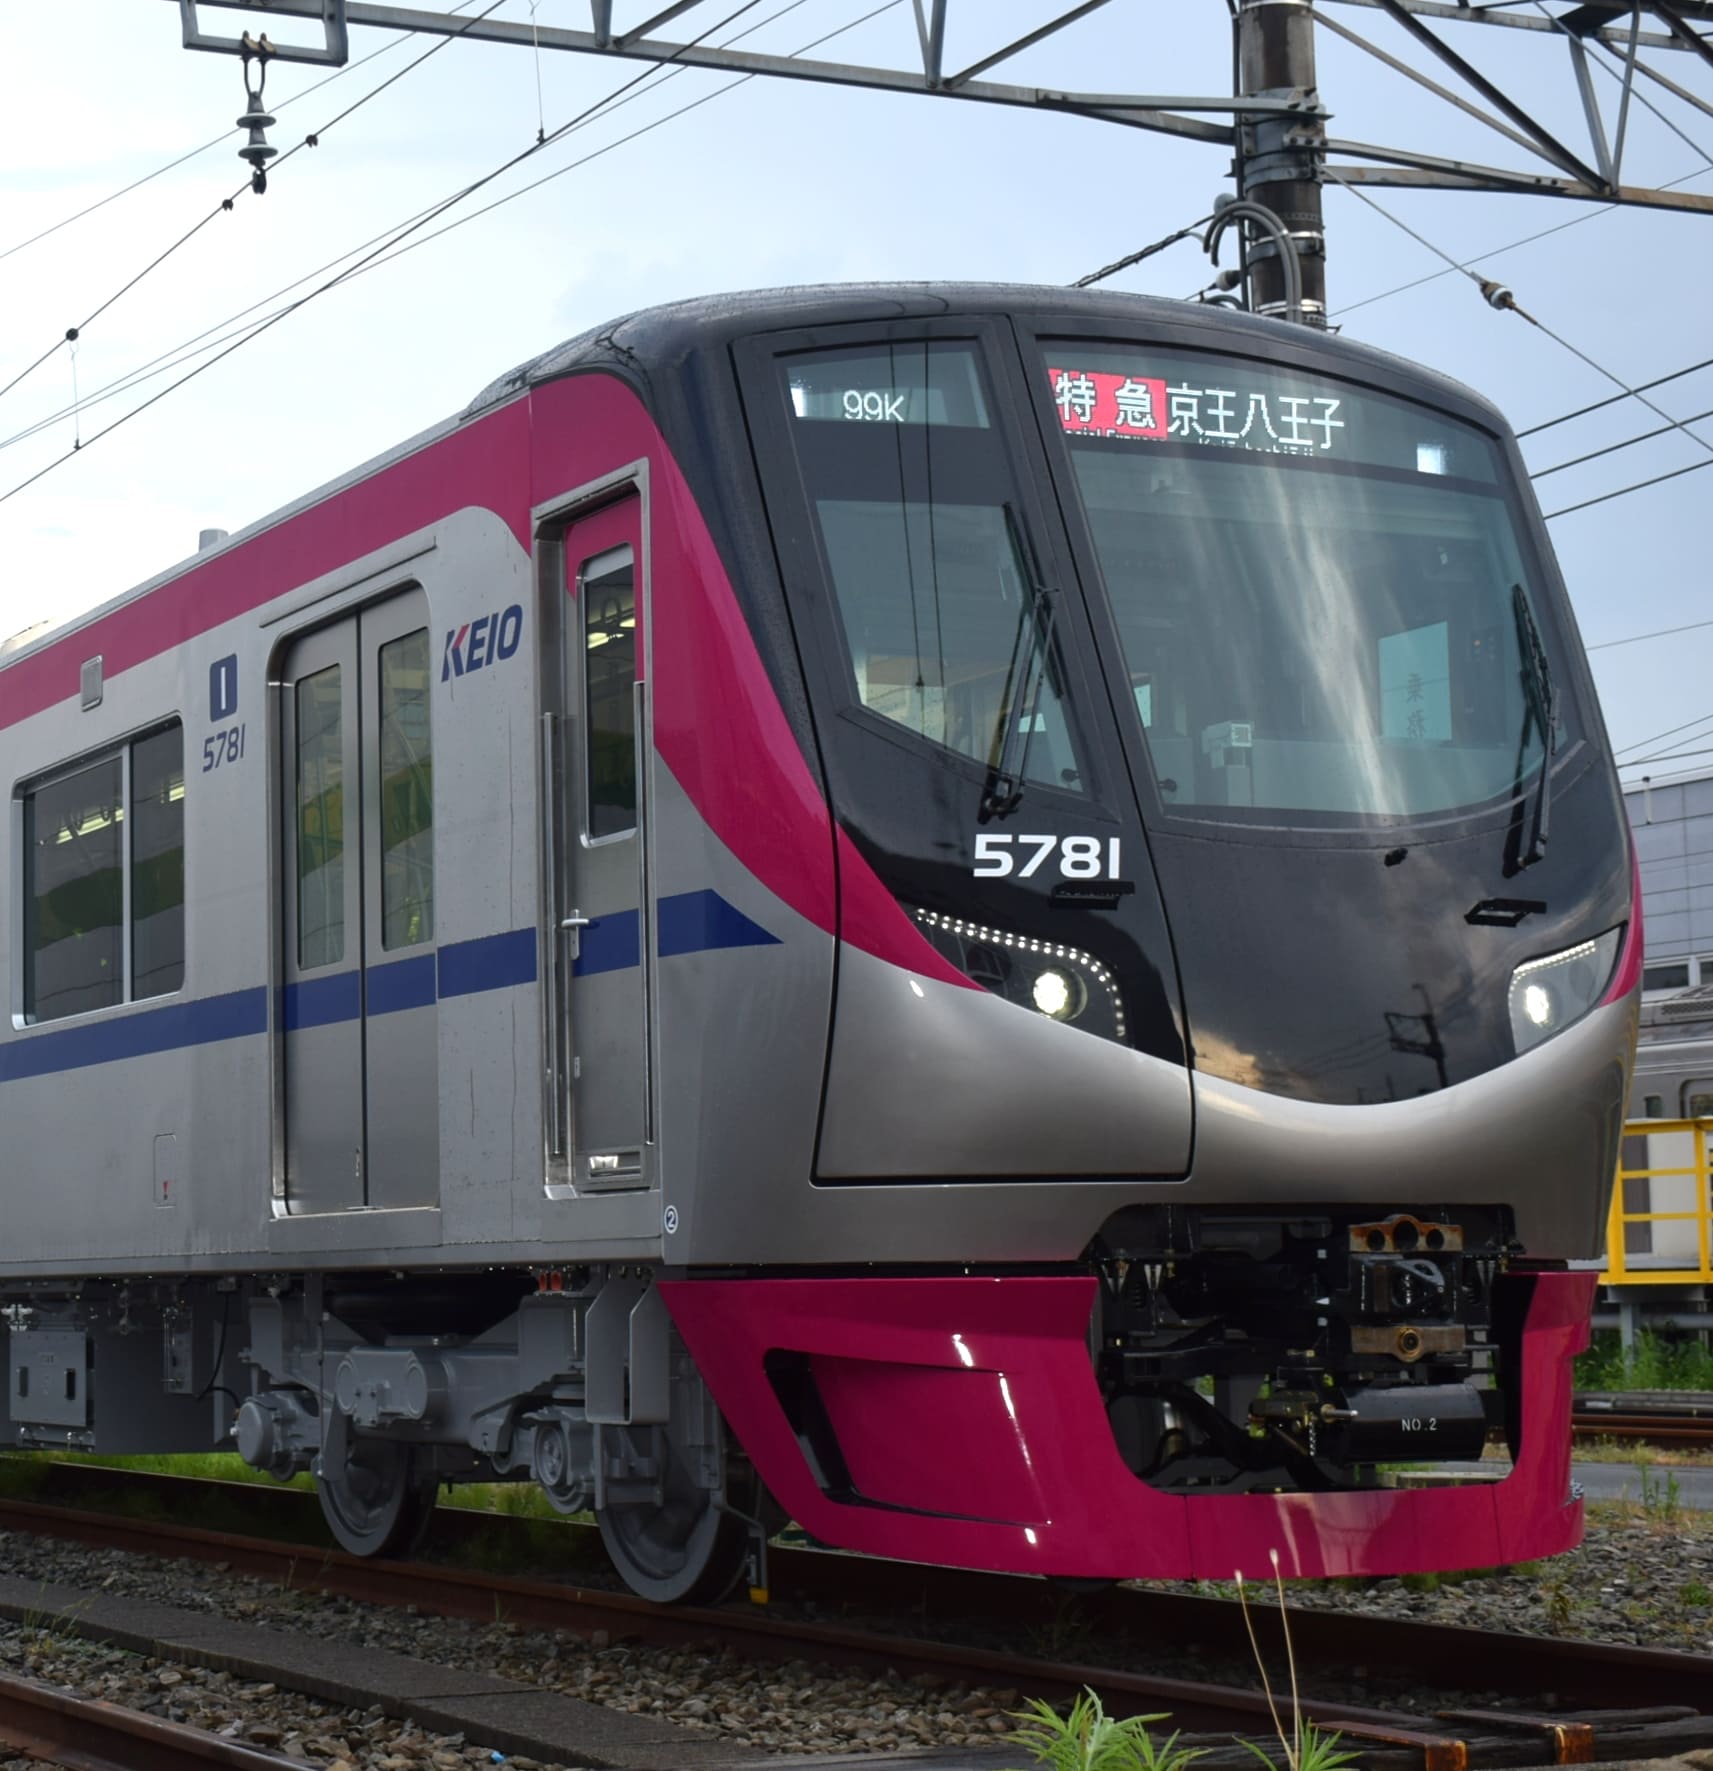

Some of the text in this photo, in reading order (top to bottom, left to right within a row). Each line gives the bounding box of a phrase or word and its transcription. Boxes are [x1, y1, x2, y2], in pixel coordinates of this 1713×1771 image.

[842, 389, 905, 422] 99K
[1055, 373, 1345, 450] 特急 京王八王子
[441, 604, 524, 683] KEIO
[202, 723, 246, 774] 5781
[973, 833, 1121, 880] 5781
